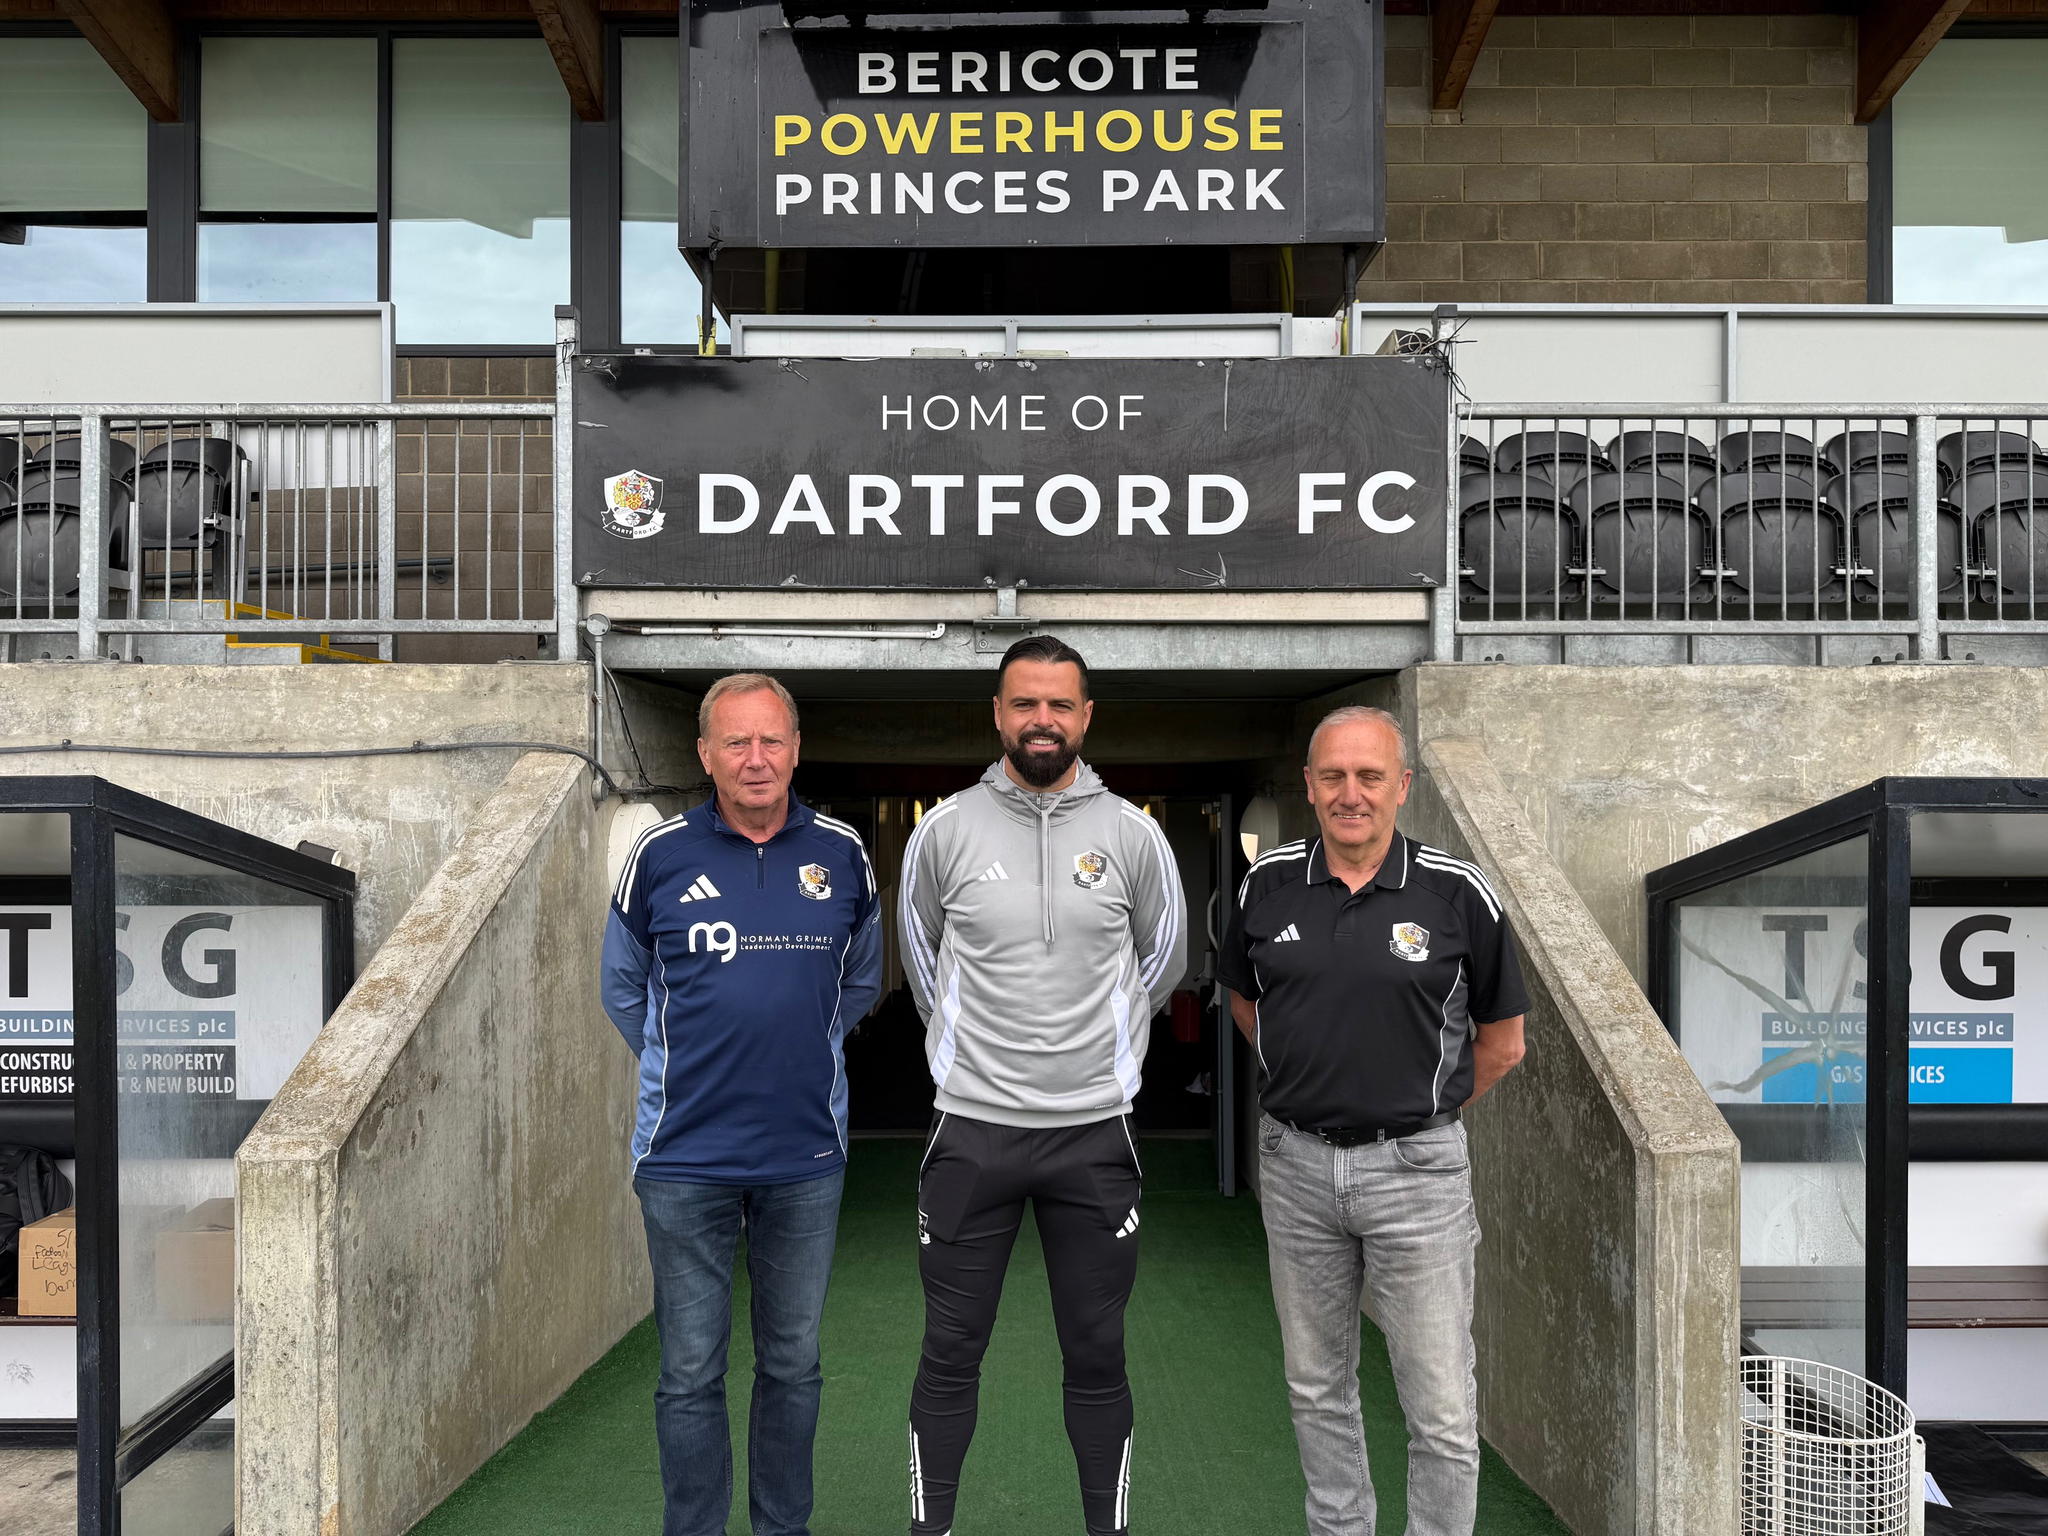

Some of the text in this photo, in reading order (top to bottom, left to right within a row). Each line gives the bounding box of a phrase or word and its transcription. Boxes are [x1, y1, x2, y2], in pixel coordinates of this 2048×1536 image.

[858, 48, 1199, 94] BERICOTE
[774, 108, 1284, 157] POWERHOUSE
[775, 168, 1286, 216] PRINCES PARK
[880, 394, 1145, 431] HOME OF
[698, 470, 1417, 537] DARTFORD FC
[740, 934, 833, 944] NORMAN GRIMES
[740, 943, 831, 951] Leadership Development
[0, 1018, 227, 1036] BUILDIN RVICES plc
[1909, 1020, 1968, 1035] VICES
[1975, 1020, 2004, 1039] plc
[125, 1053, 137, 1070] &
[141, 1053, 224, 1071] PROPERTY
[130, 1077, 142, 1094] &
[145, 1077, 182, 1094] NEW
[186, 1076, 235, 1094] BUILD
